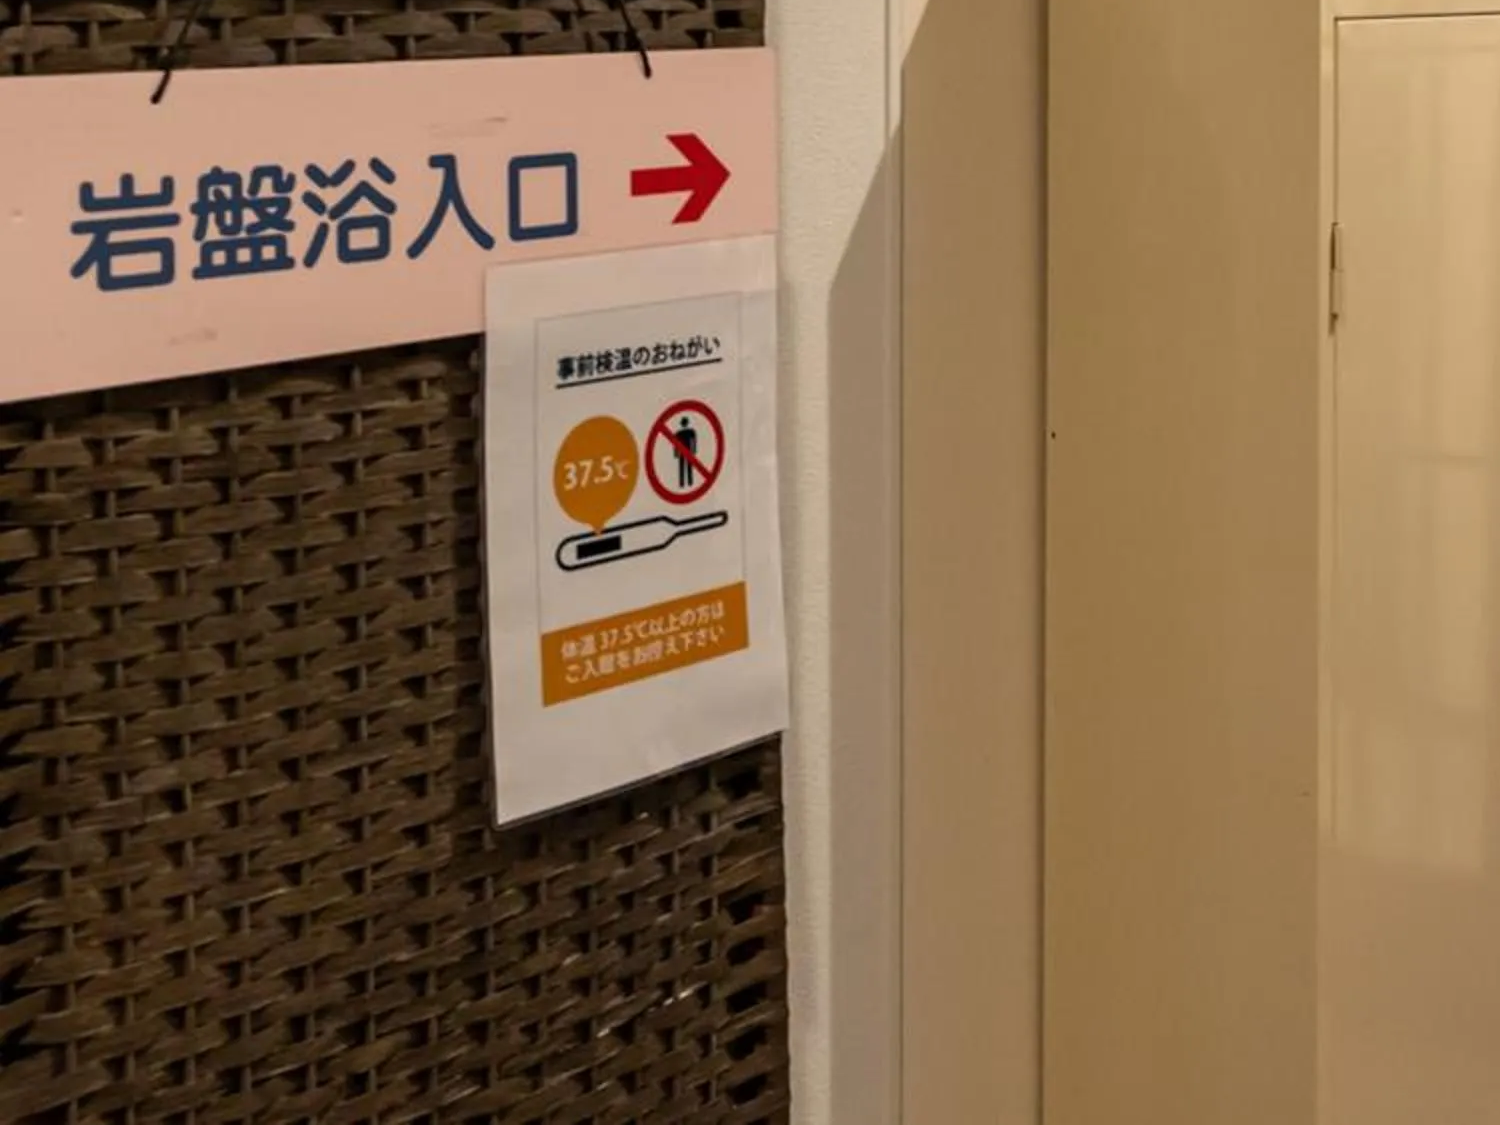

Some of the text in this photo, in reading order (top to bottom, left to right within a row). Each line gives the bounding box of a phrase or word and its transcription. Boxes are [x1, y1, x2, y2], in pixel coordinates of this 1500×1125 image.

[69, 151, 579, 293] 岩盤浴入口
[556, 335, 722, 380] 事前検温のおねがい
[563, 454, 630, 491] 37.5℃
